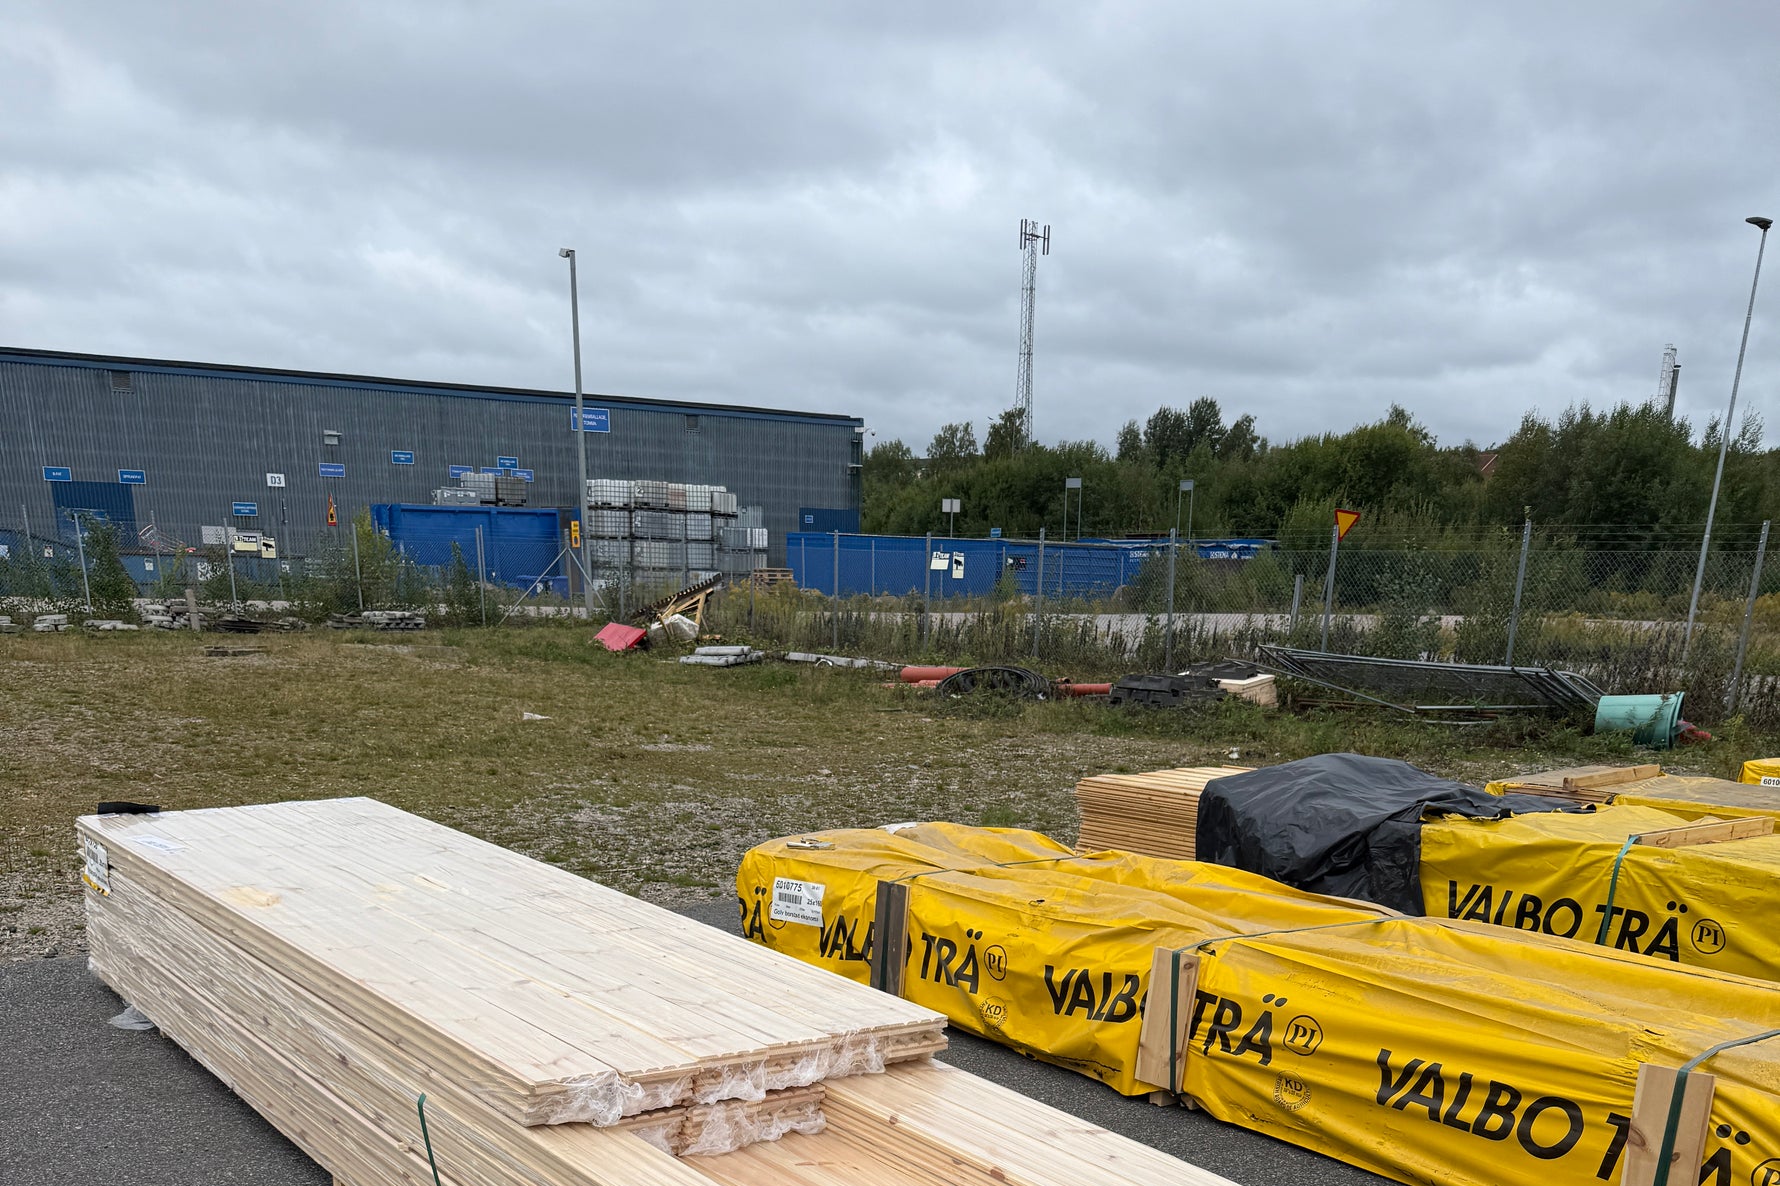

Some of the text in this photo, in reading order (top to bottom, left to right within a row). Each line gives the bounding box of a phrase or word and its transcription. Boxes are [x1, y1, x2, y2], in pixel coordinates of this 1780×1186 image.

[270, 475, 282, 485] D3
[1448, 880, 1583, 939] VALBO
[1595, 901, 1688, 962] TRÄ
[921, 928, 984, 994] TRÄ
[985, 1004, 1002, 1016] KD
[1044, 964, 1149, 1023] VALB
[1190, 989, 1288, 1067] TRÄ
[1285, 1077, 1303, 1092] KD
[1375, 1048, 1585, 1160] VALBO
